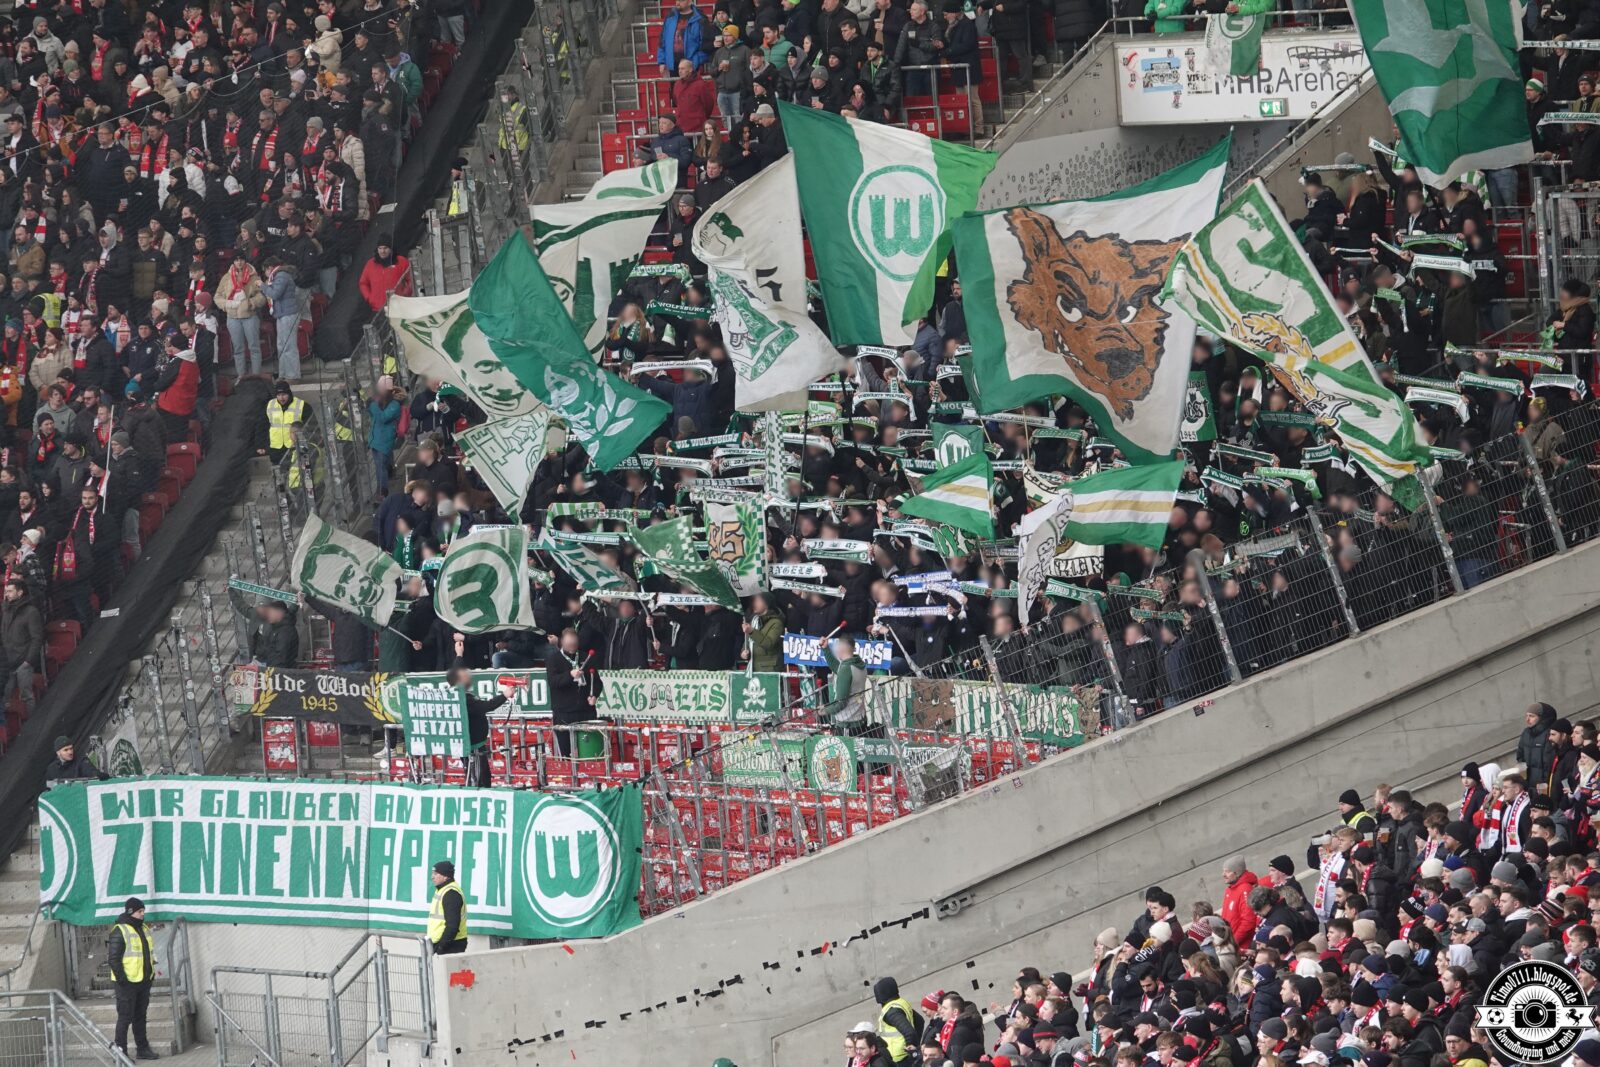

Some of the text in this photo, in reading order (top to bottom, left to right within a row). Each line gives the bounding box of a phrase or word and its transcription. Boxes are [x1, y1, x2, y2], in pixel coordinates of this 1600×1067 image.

[301, 695, 338, 712] 1945
[408, 701, 462, 719] WAPPEN
[411, 720, 463, 736] JETZT!
[101, 788, 507, 828] WIR GLAUBEN AN UNSER
